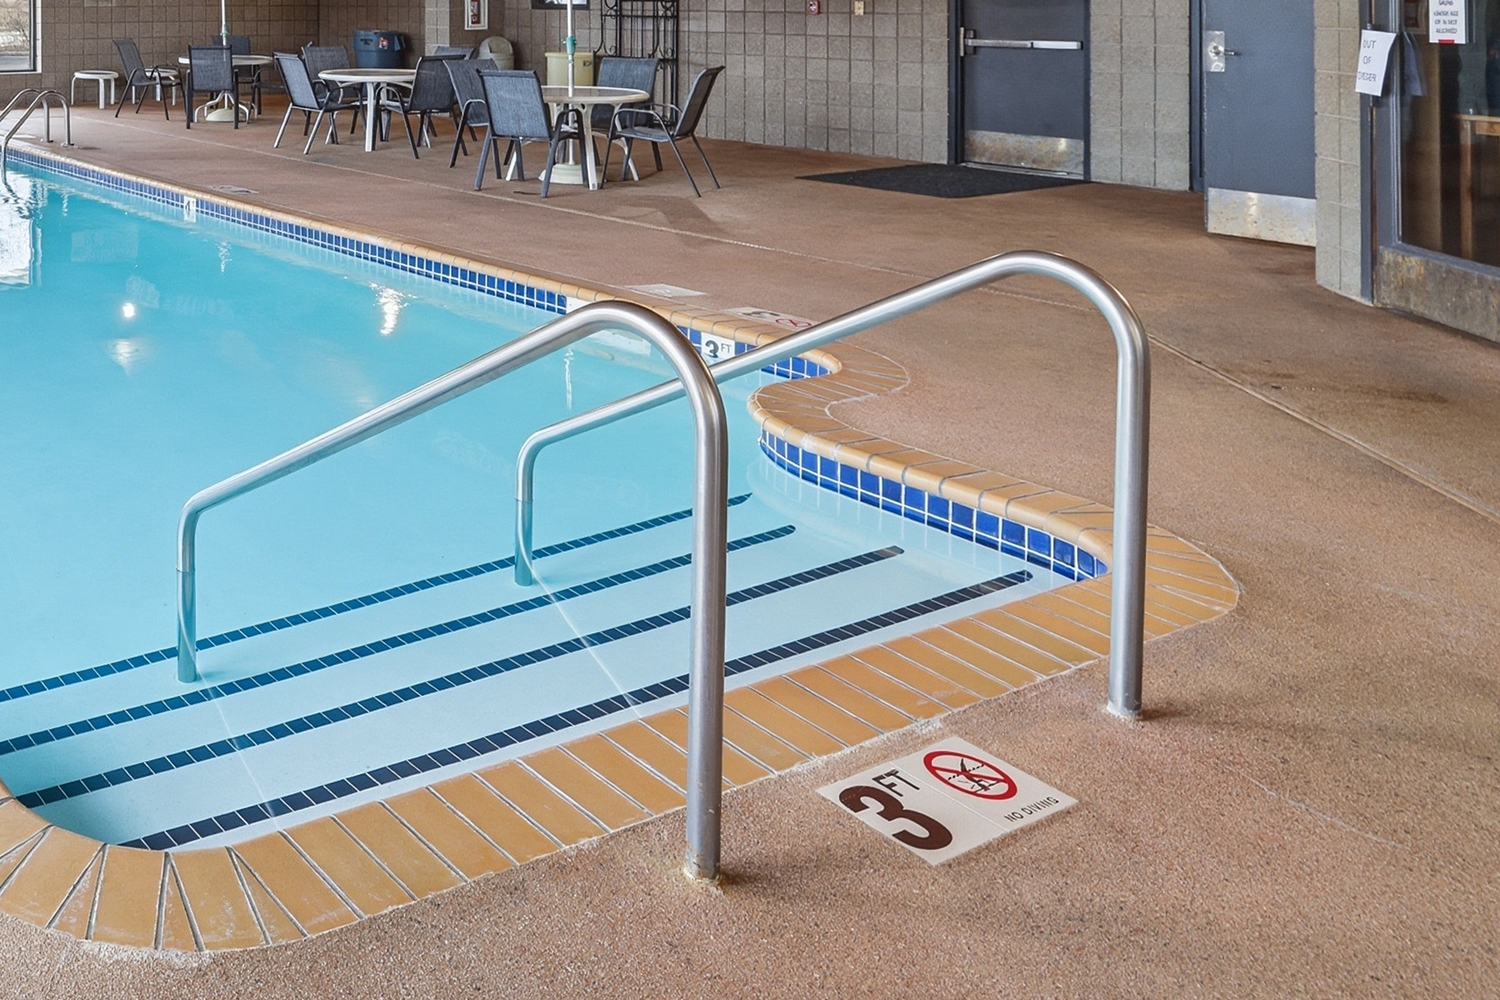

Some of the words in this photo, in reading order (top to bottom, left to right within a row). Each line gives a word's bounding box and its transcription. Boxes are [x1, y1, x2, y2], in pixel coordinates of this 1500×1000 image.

[721, 342, 732, 354] FT
[872, 768, 920, 798] FT
[838, 785, 953, 850] 3
[1003, 811, 1024, 823] NO
[1020, 796, 1060, 816] DIVING
